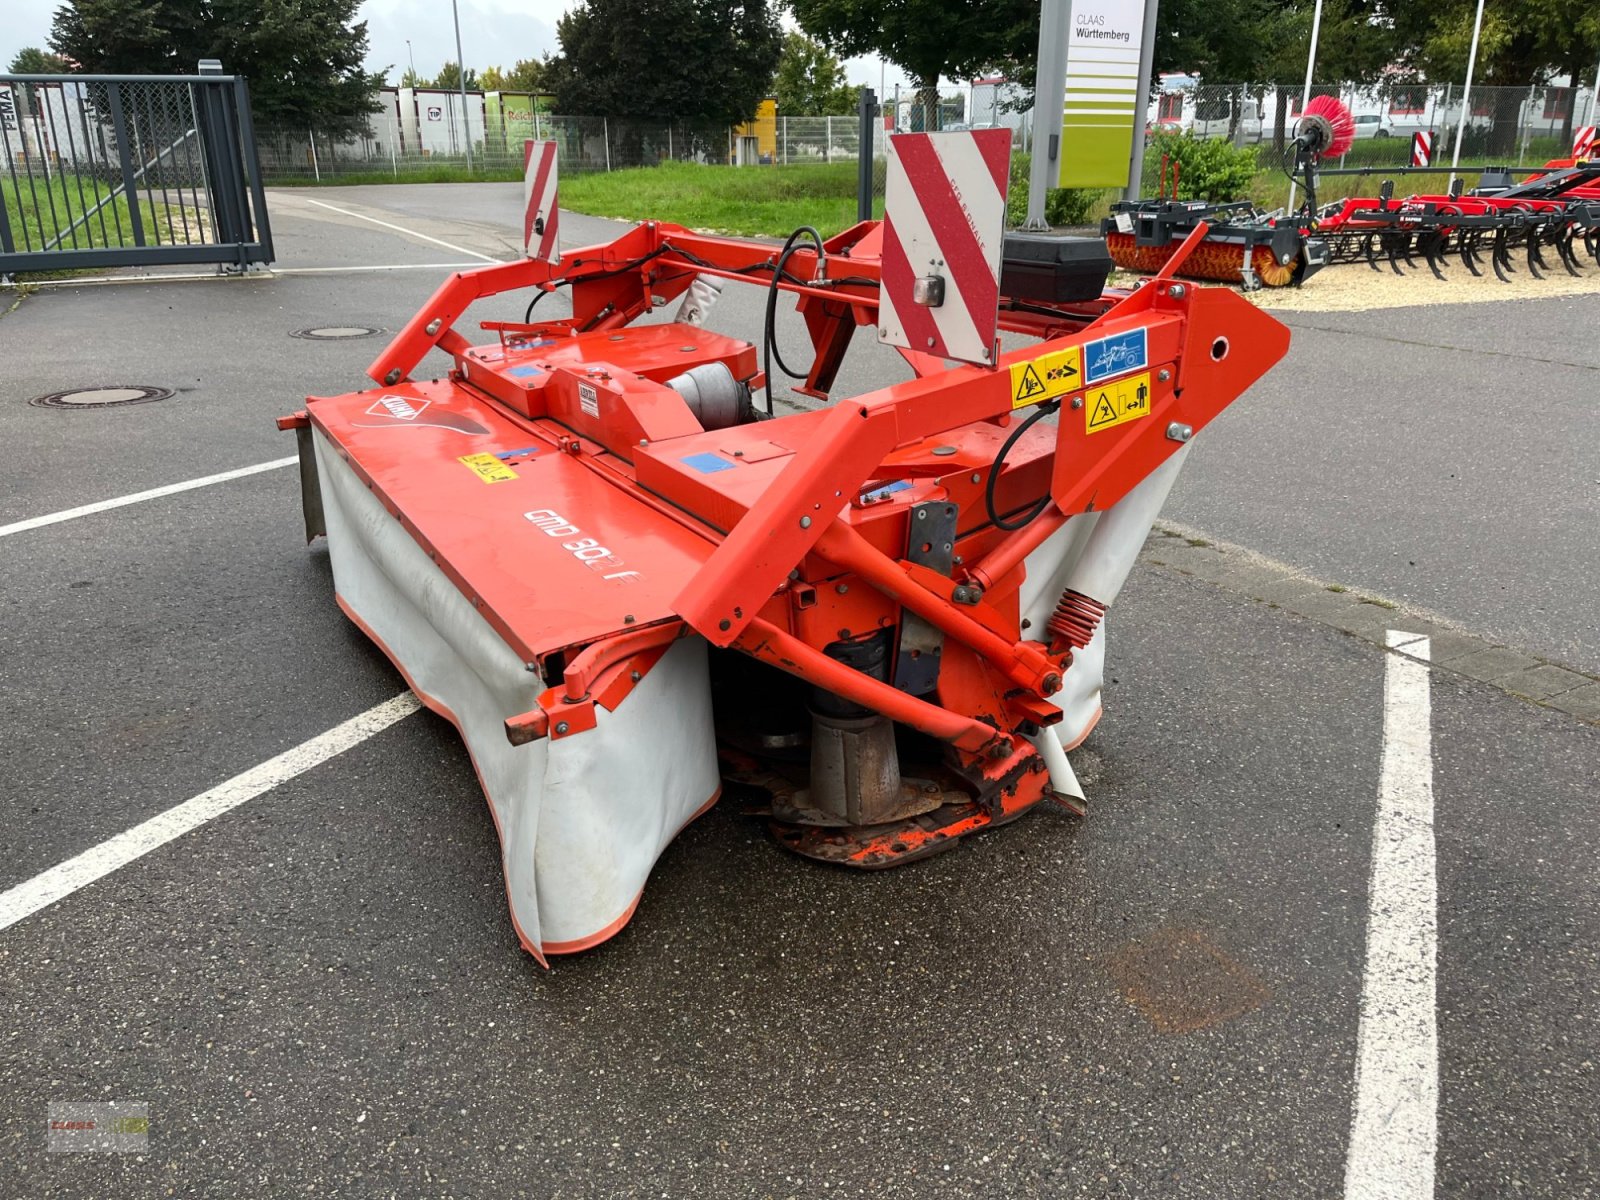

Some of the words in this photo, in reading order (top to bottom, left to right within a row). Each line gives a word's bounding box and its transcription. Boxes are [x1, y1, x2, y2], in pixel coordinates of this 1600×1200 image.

[1077, 14, 1105, 26] CLAAS
[1076, 28, 1130, 42] Württemberg
[0, 90, 18, 131] PEMA
[380, 397, 419, 418] KUHN
[523, 509, 581, 537] GMD
